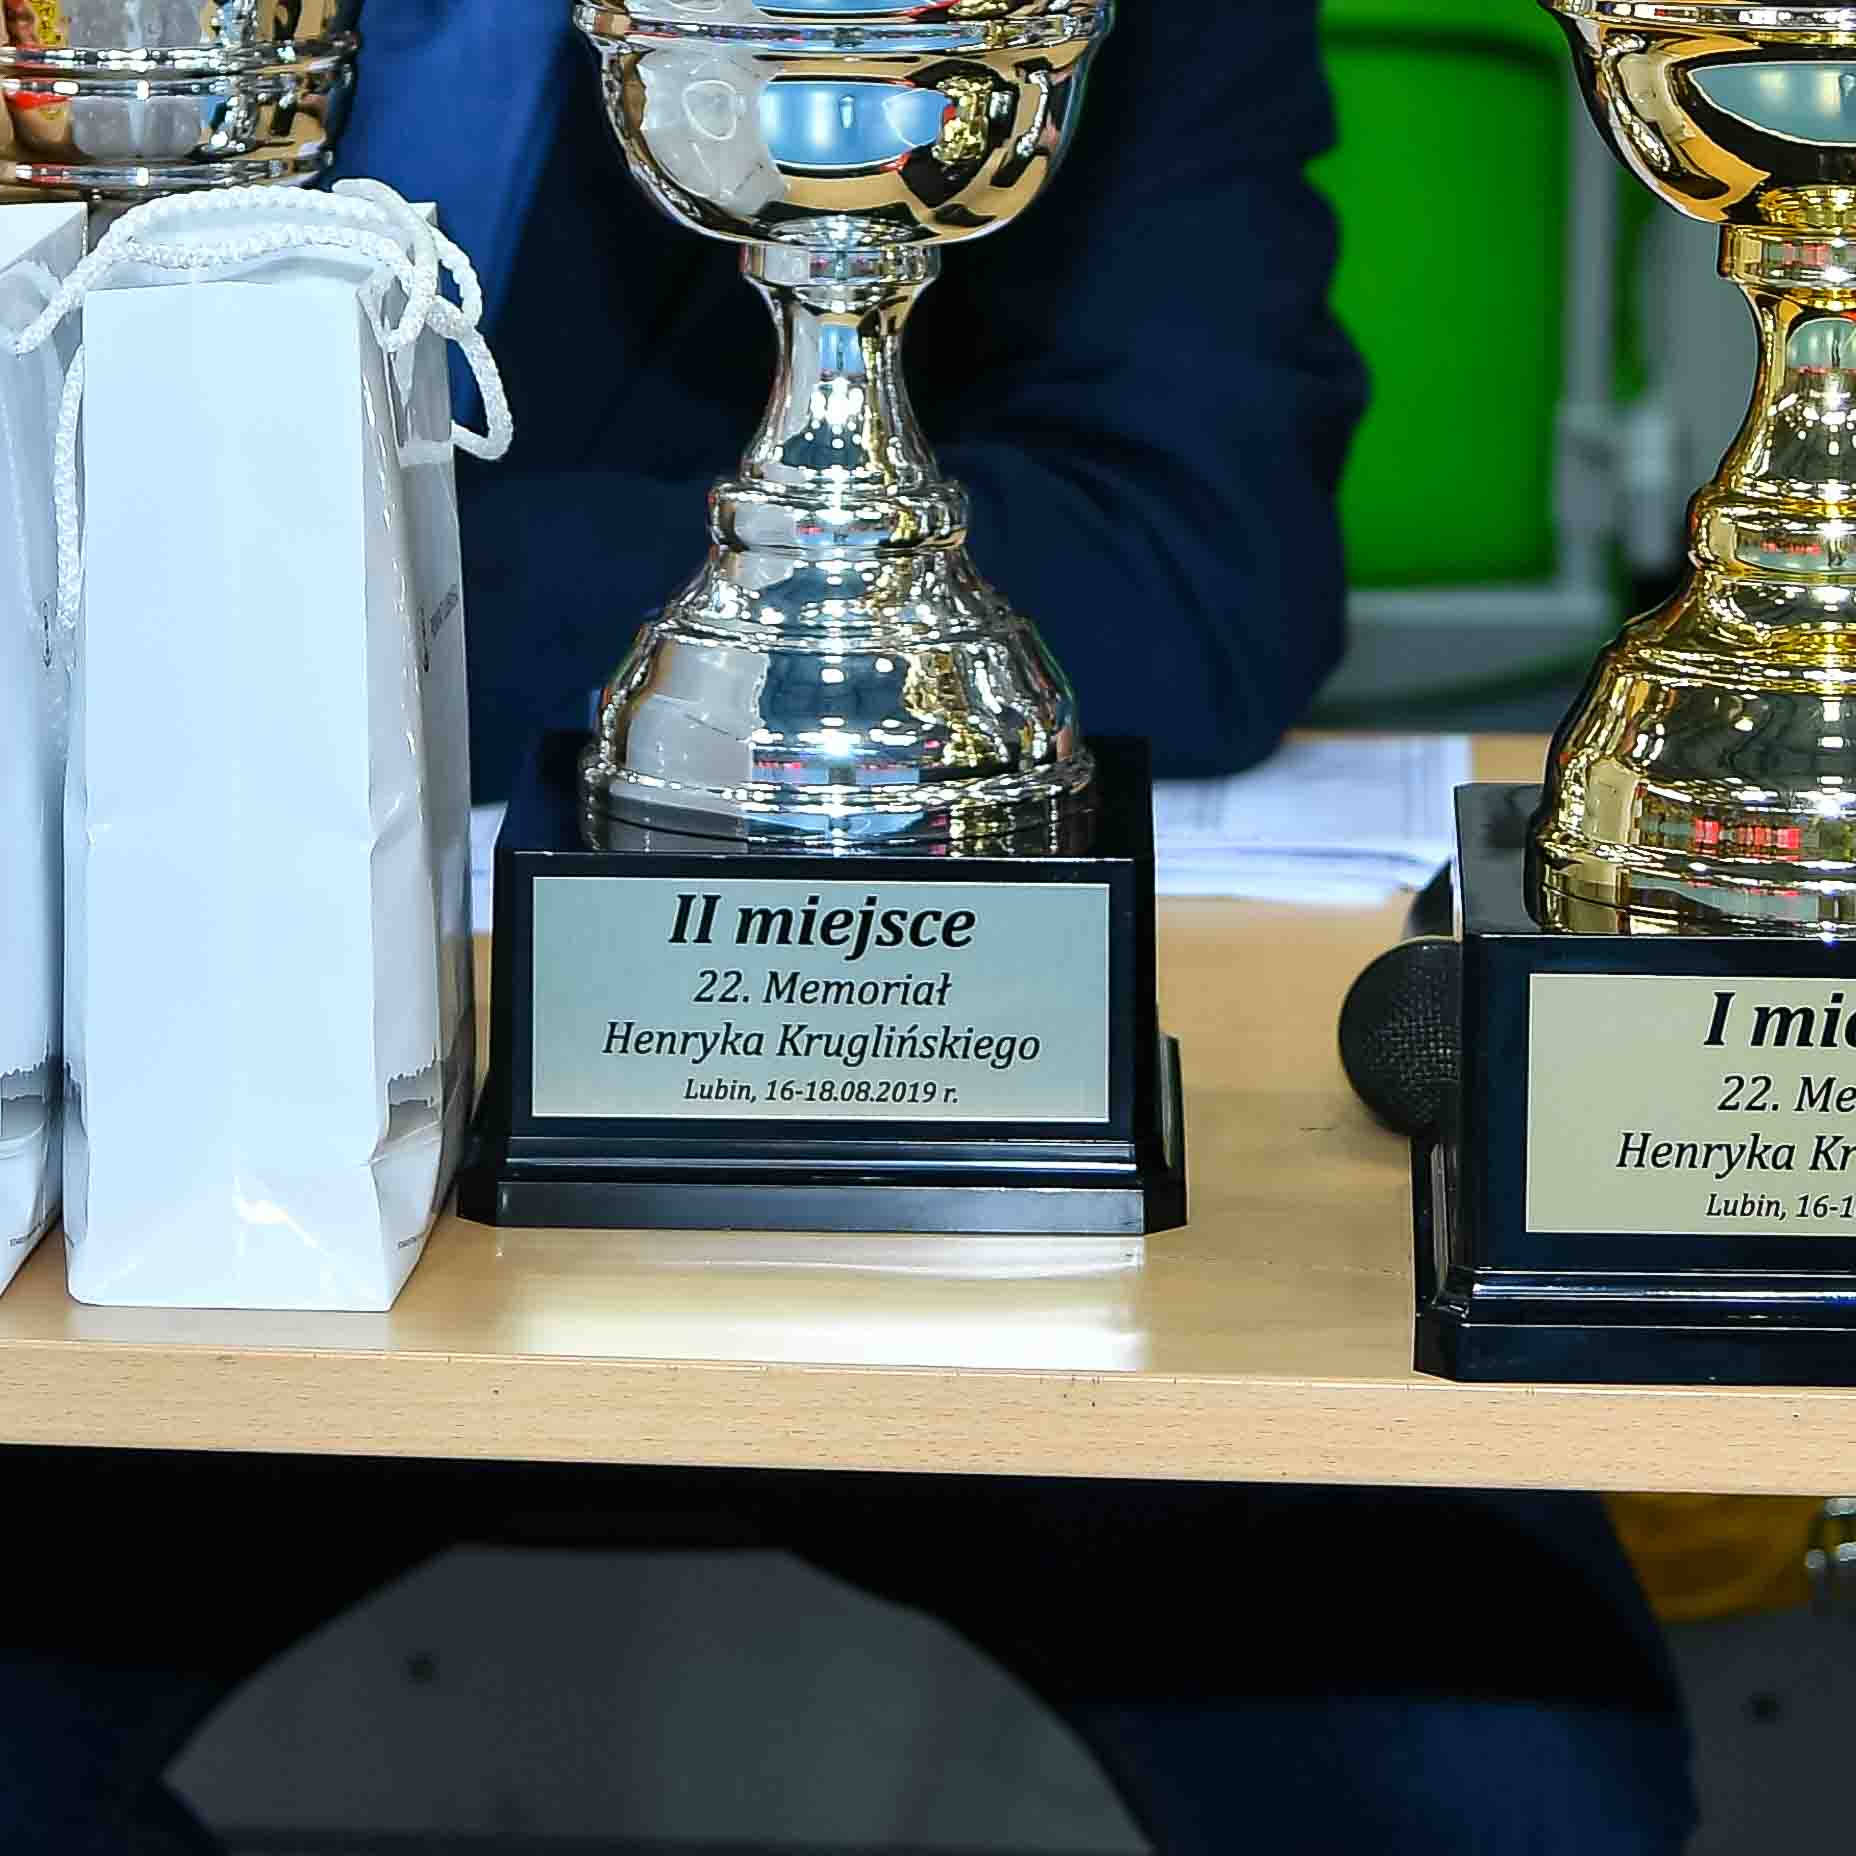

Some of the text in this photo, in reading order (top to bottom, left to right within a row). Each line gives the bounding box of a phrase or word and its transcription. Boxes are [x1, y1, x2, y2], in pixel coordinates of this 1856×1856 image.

[668, 894, 977, 961] II miejsce
[693, 969, 953, 1006] 22. Memoriał
[1703, 991, 1737, 1047] I
[602, 1021, 1041, 1070] Henryka Kruglińskiego
[684, 1078, 959, 1105] Lubin, 16-18.08.2019 r.
[1717, 1075, 1781, 1113] 22.
[1615, 1132, 1797, 1181] Henryka
[1706, 1192, 1787, 1222] Lubin,
